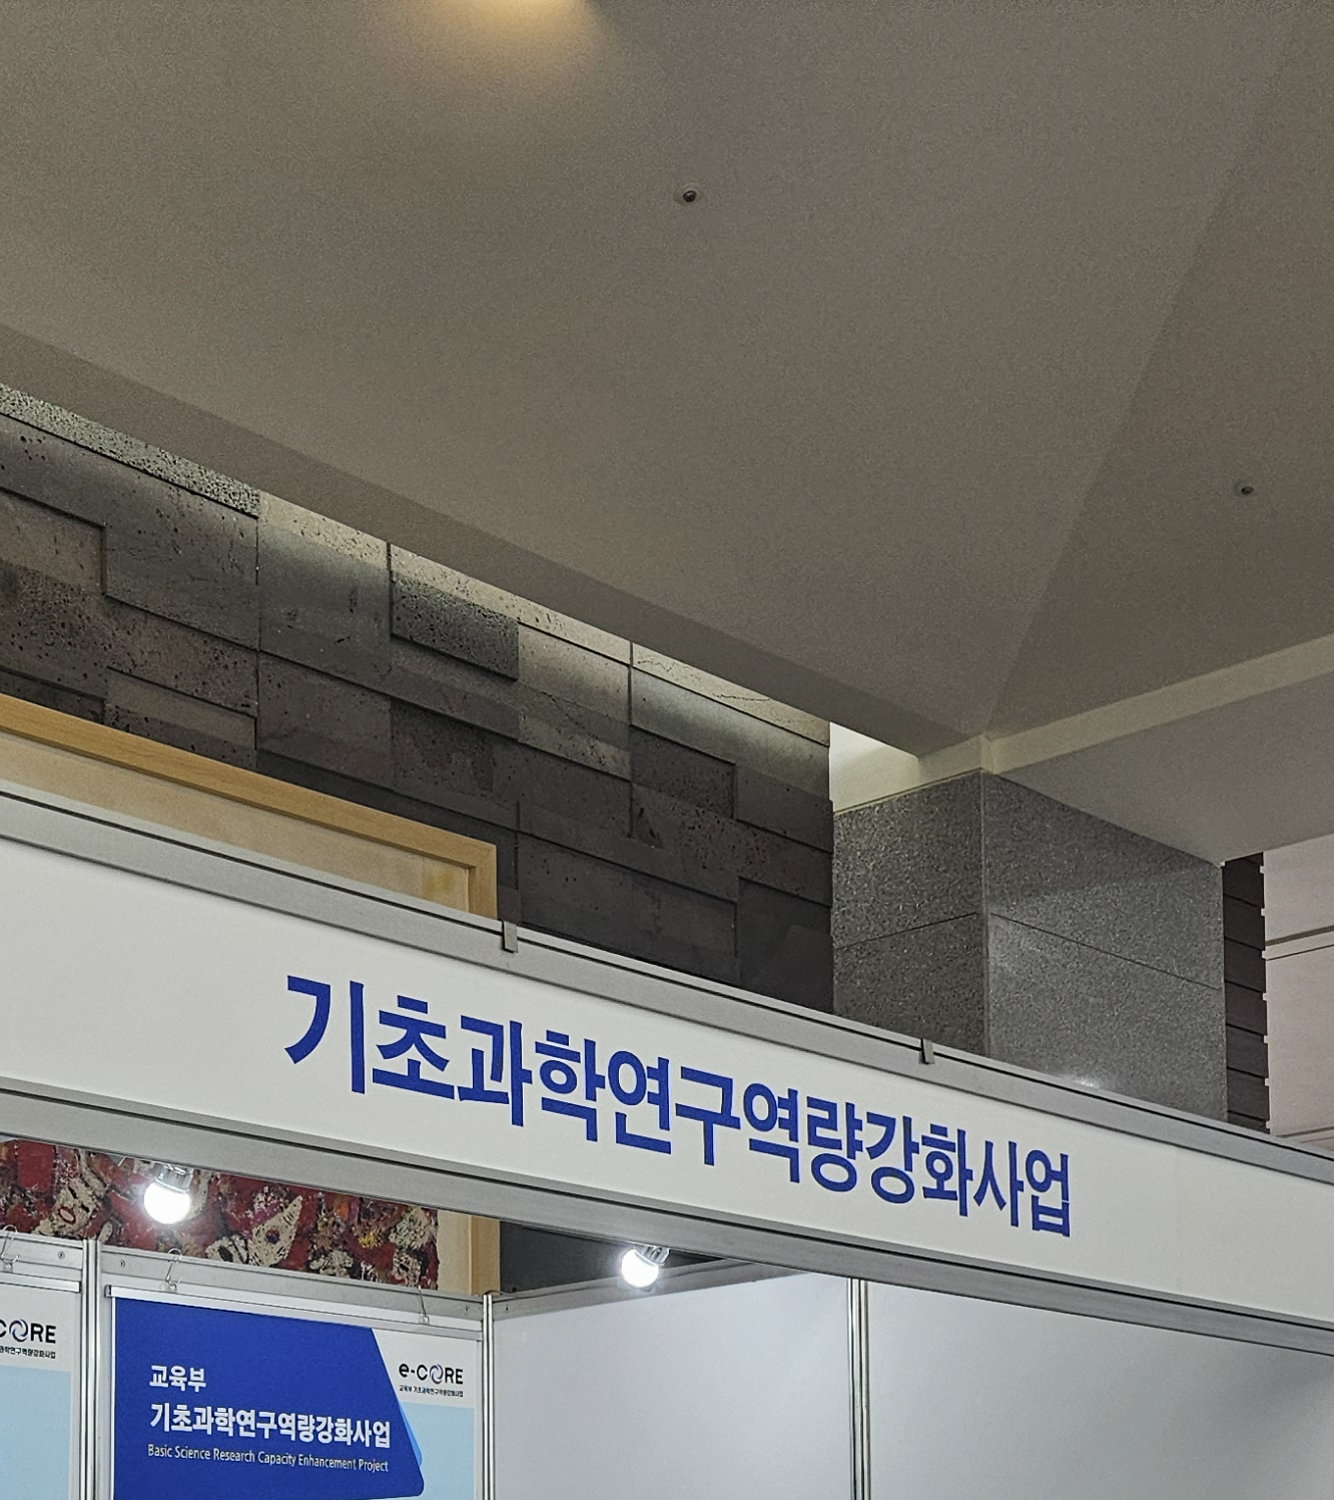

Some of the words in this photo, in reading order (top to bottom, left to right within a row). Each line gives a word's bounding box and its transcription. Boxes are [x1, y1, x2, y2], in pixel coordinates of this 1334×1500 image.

[284, 975, 1070, 1237] 기초과학연구역량강화사업
[150, 1366, 206, 1392] 교육부
[151, 1403, 389, 1448] 기초과학연구역량강화사업
